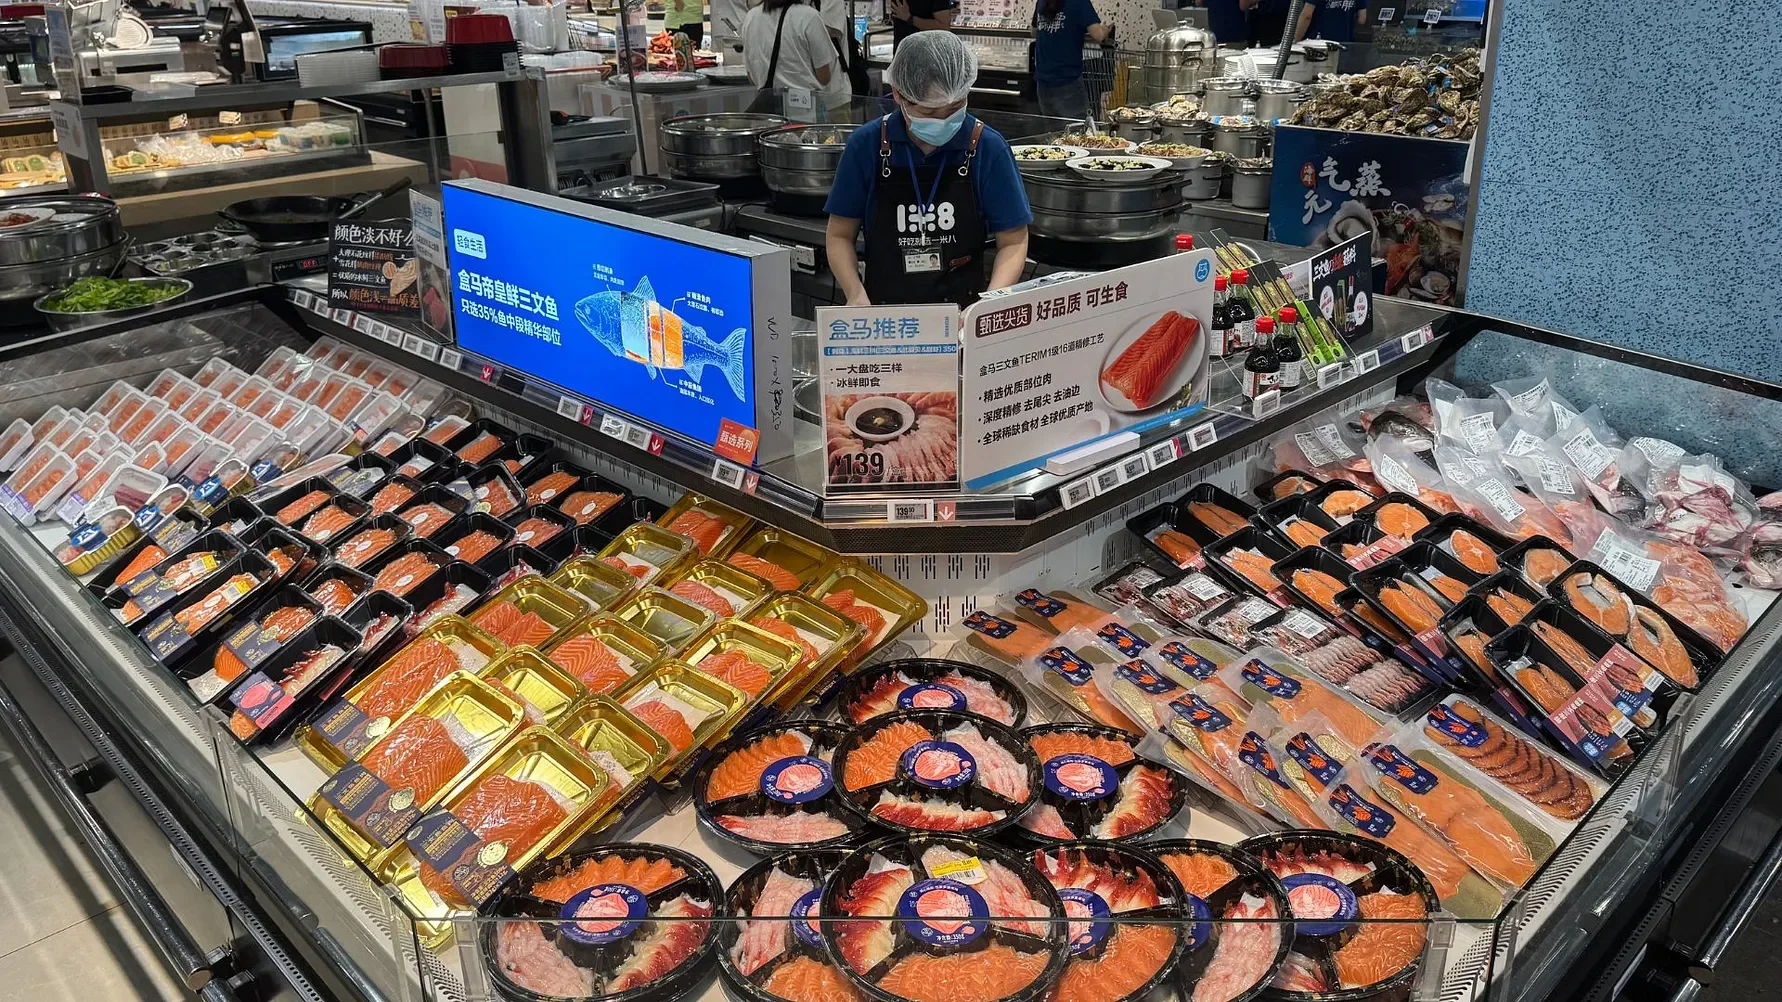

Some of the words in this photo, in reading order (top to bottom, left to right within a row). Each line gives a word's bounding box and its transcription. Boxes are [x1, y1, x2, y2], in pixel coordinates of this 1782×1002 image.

[456, 234, 485, 254] 轻食生活
[458, 269, 559, 322] 盒马帝皇鲜三文鱼
[979, 306, 1030, 337] 甄选尖货
[1036, 292, 1081, 322] 好品质
[1086, 281, 1129, 309] 可生食
[461, 300, 562, 347] 只选35%鱼中段精华部位
[828, 316, 921, 341] 盒马推荐
[835, 363, 903, 374] 一大盘吃三样
[836, 377, 881, 388] 冰鲜即食
[984, 372, 1052, 404] 精选优质部位肉
[983, 403, 1022, 426] 深度精修
[1024, 393, 1051, 412] 去尾尖
[1053, 384, 1081, 403] 去油边
[982, 415, 1040, 446] 全球稀缺食材
[1040, 400, 1094, 427] 全球优质产地
[719, 430, 753, 453] 甄选系列
